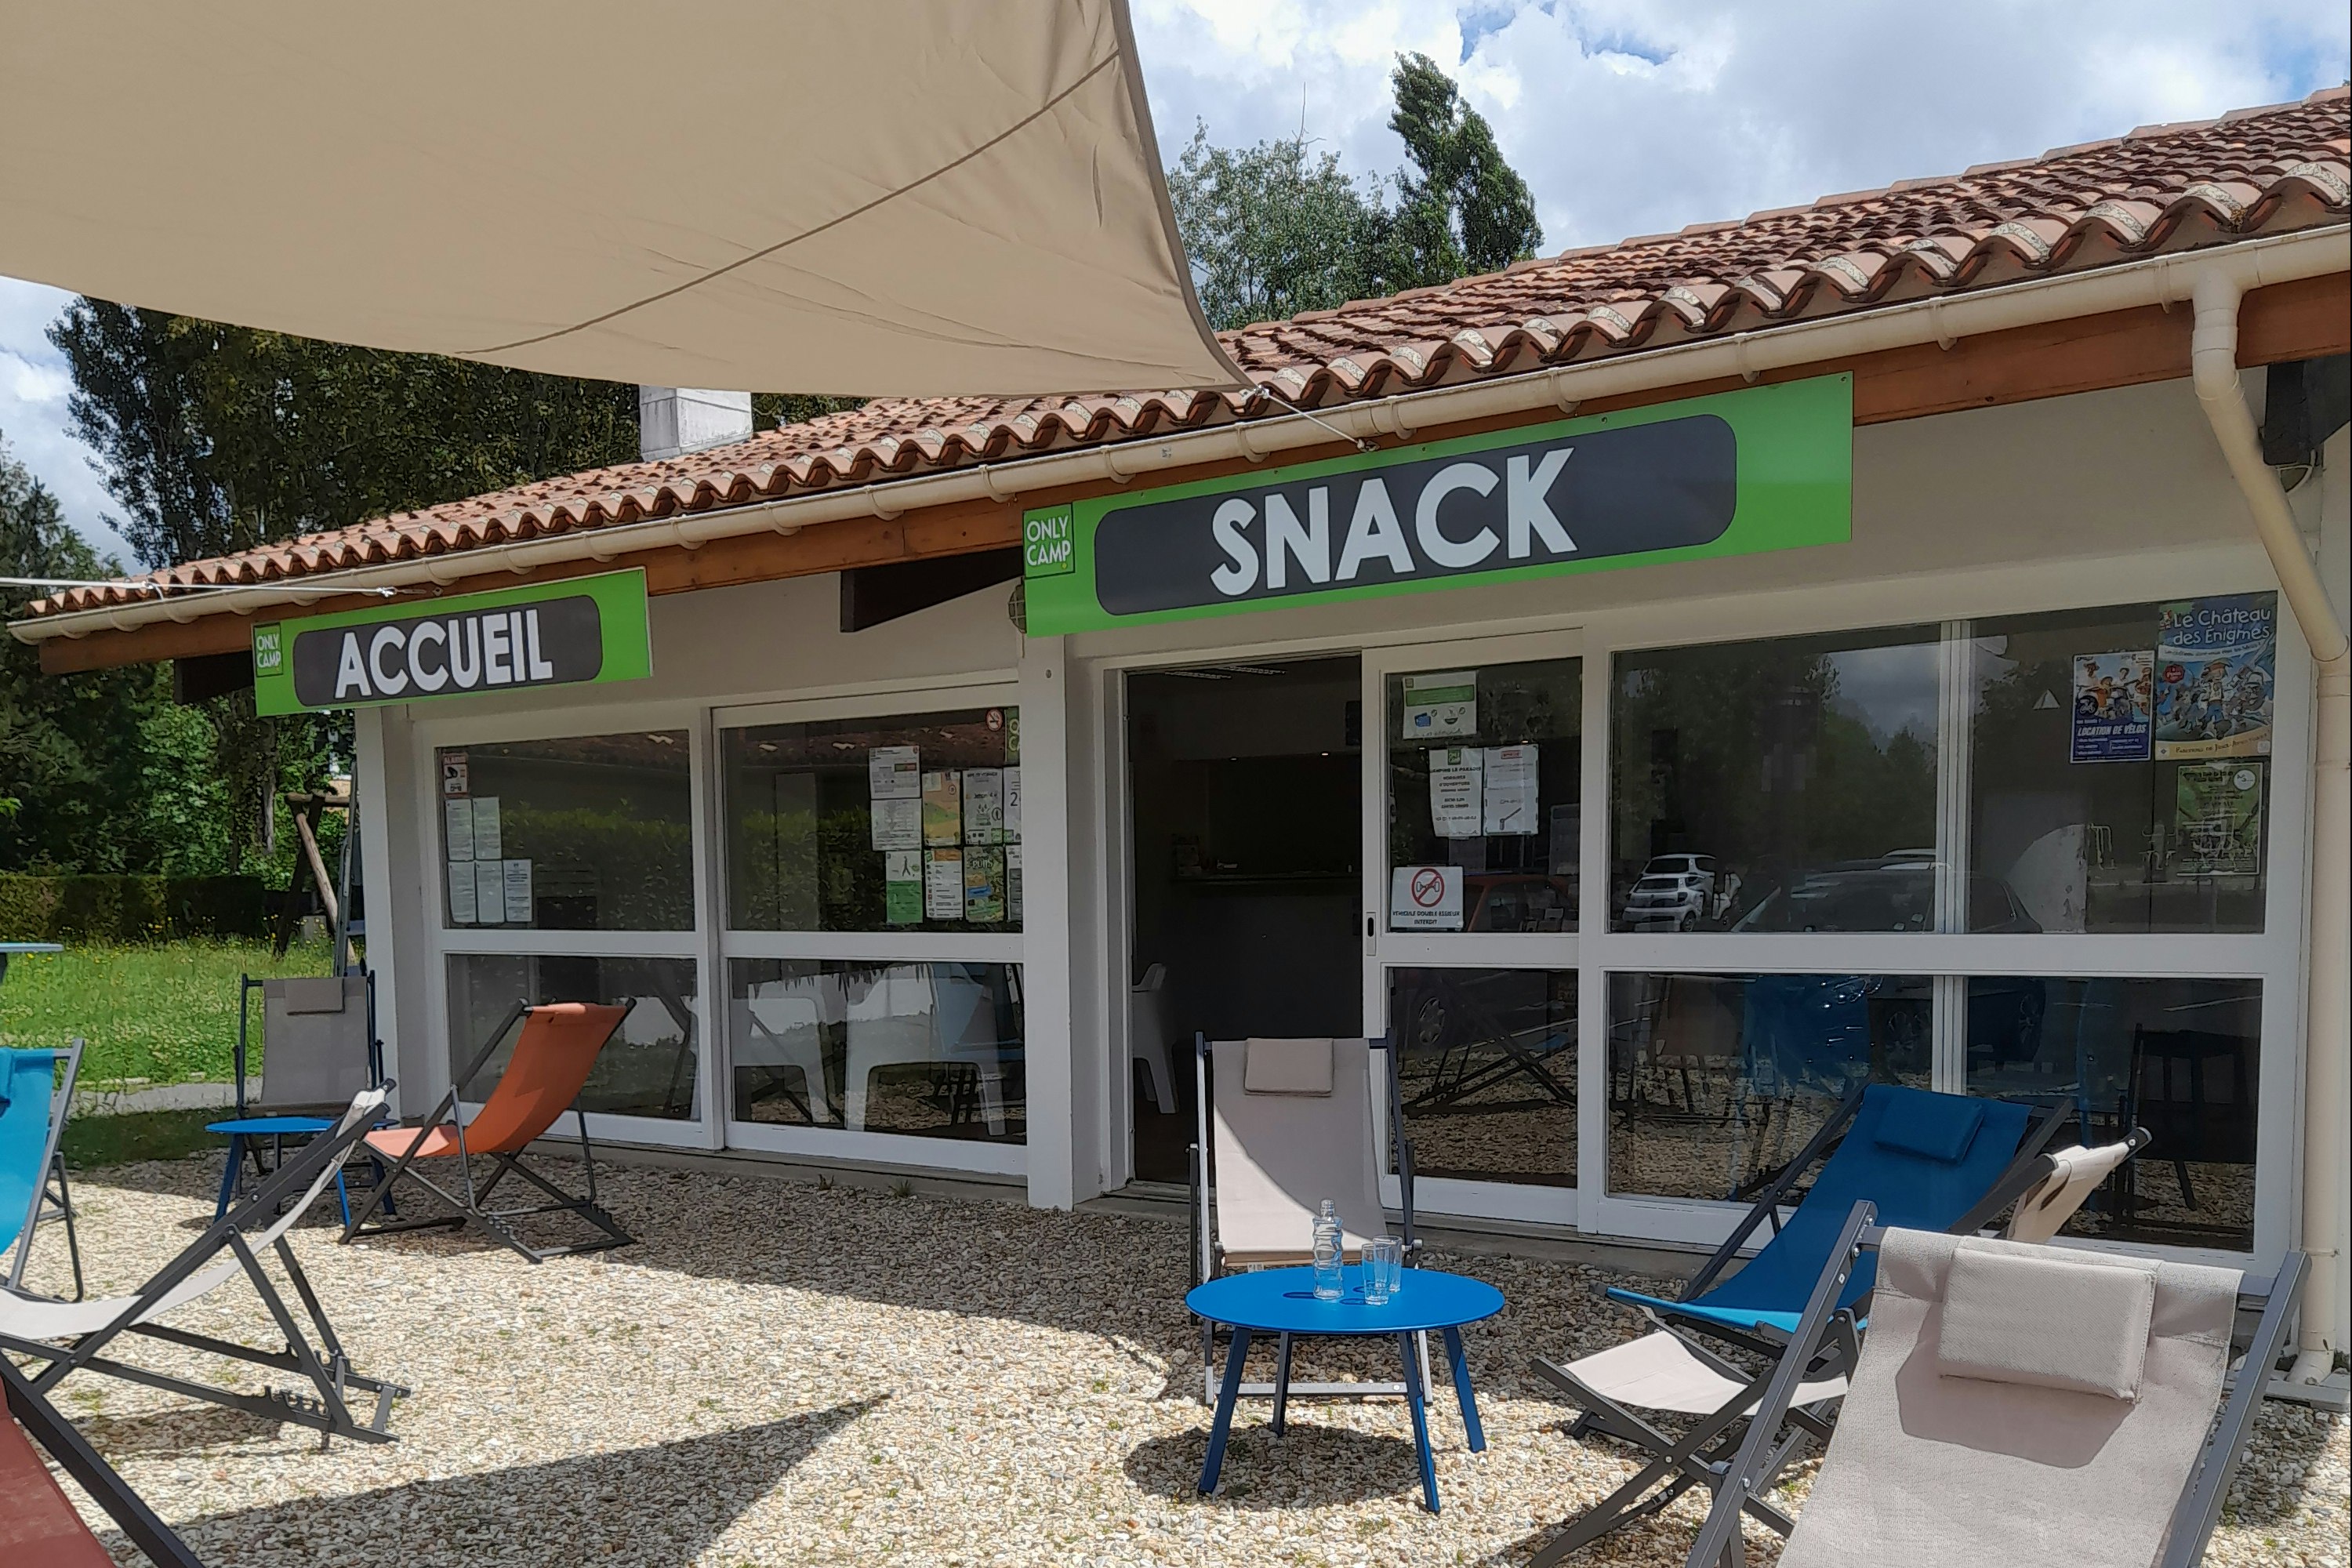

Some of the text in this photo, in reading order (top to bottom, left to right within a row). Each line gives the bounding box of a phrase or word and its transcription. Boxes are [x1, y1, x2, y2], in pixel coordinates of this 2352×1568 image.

[1026, 514, 1069, 543] ONLY
[1209, 448, 1578, 597] SNACK
[1026, 539, 1071, 566] CAMP
[2173, 608, 2270, 628] Le Château
[256, 633, 279, 651] ONLY
[2173, 626, 2270, 645] des Énigmes
[256, 651, 281, 668] CAMP
[334, 608, 554, 699] ACCUEIL
